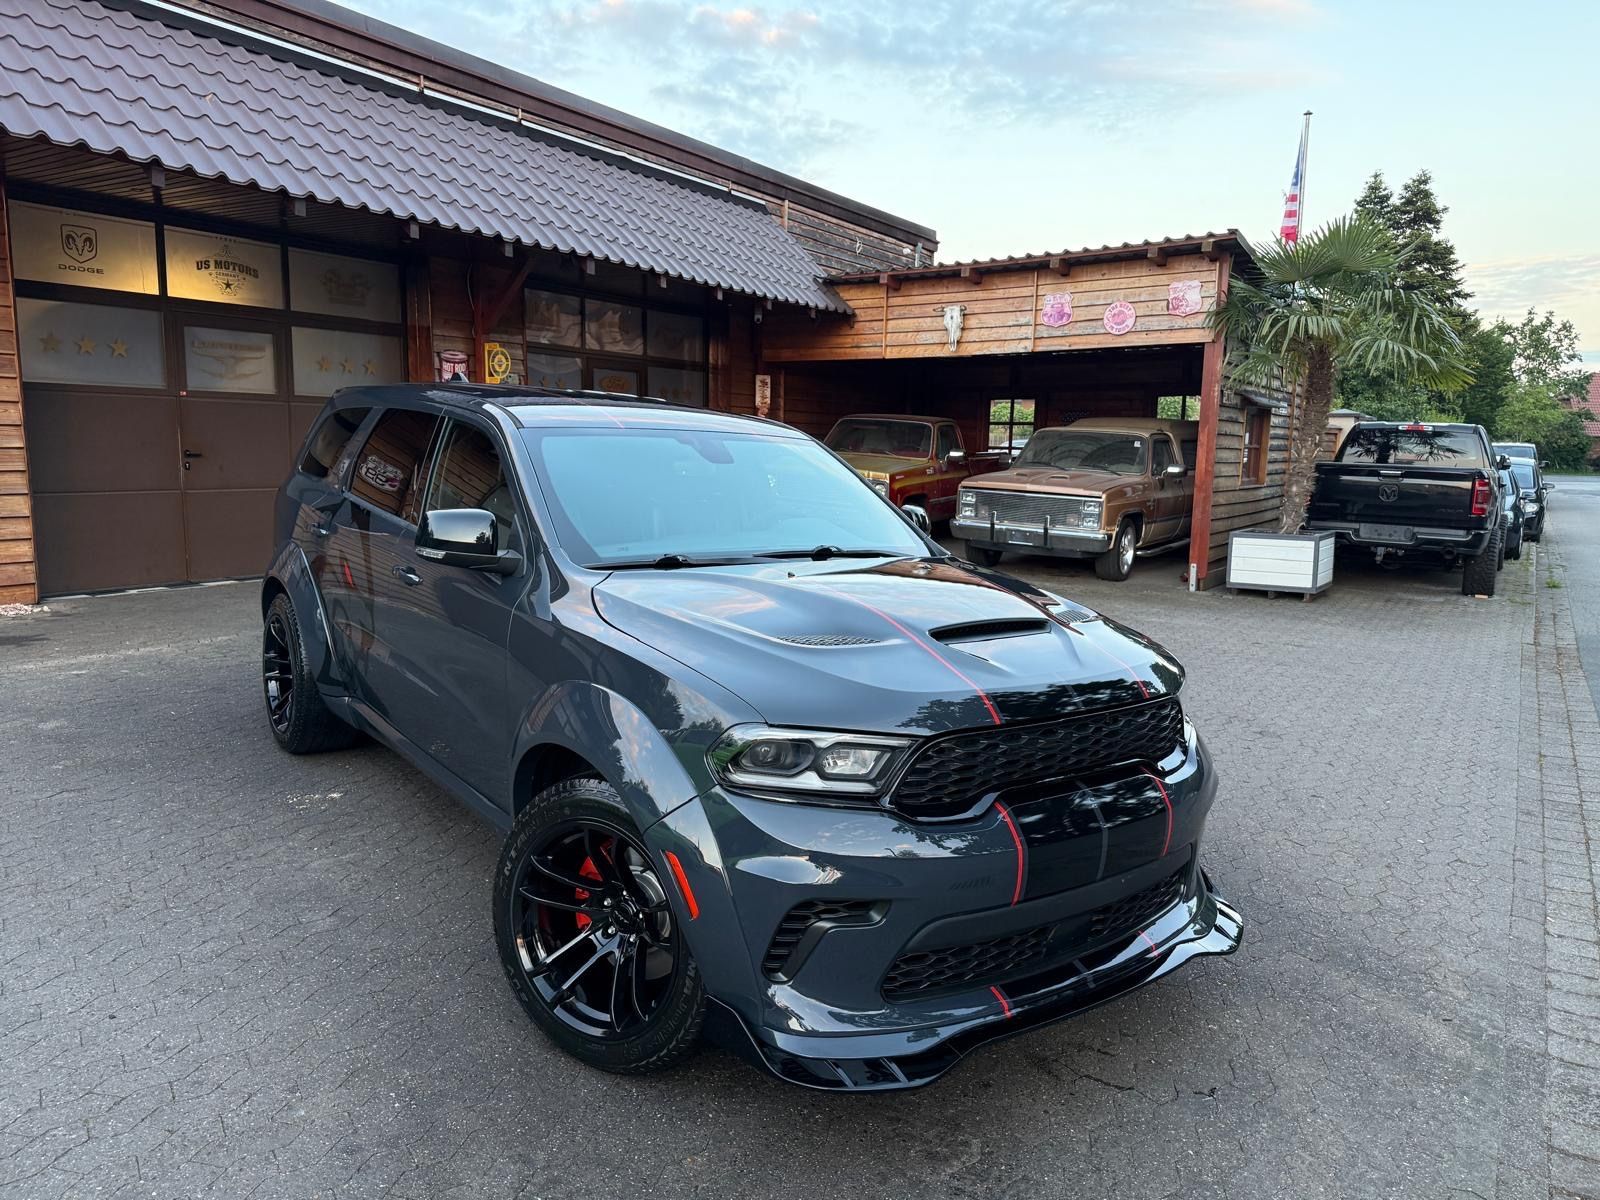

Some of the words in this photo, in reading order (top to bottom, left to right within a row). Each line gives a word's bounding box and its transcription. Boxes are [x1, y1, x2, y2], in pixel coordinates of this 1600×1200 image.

[58, 263, 105, 275] DODGE
[196, 259, 211, 270] US
[214, 259, 260, 279] MOTORS
[215, 271, 240, 279] GERMANY
[1108, 303, 1118, 313] THE
[442, 360, 454, 373] HOT
[454, 362, 466, 374] ROD
